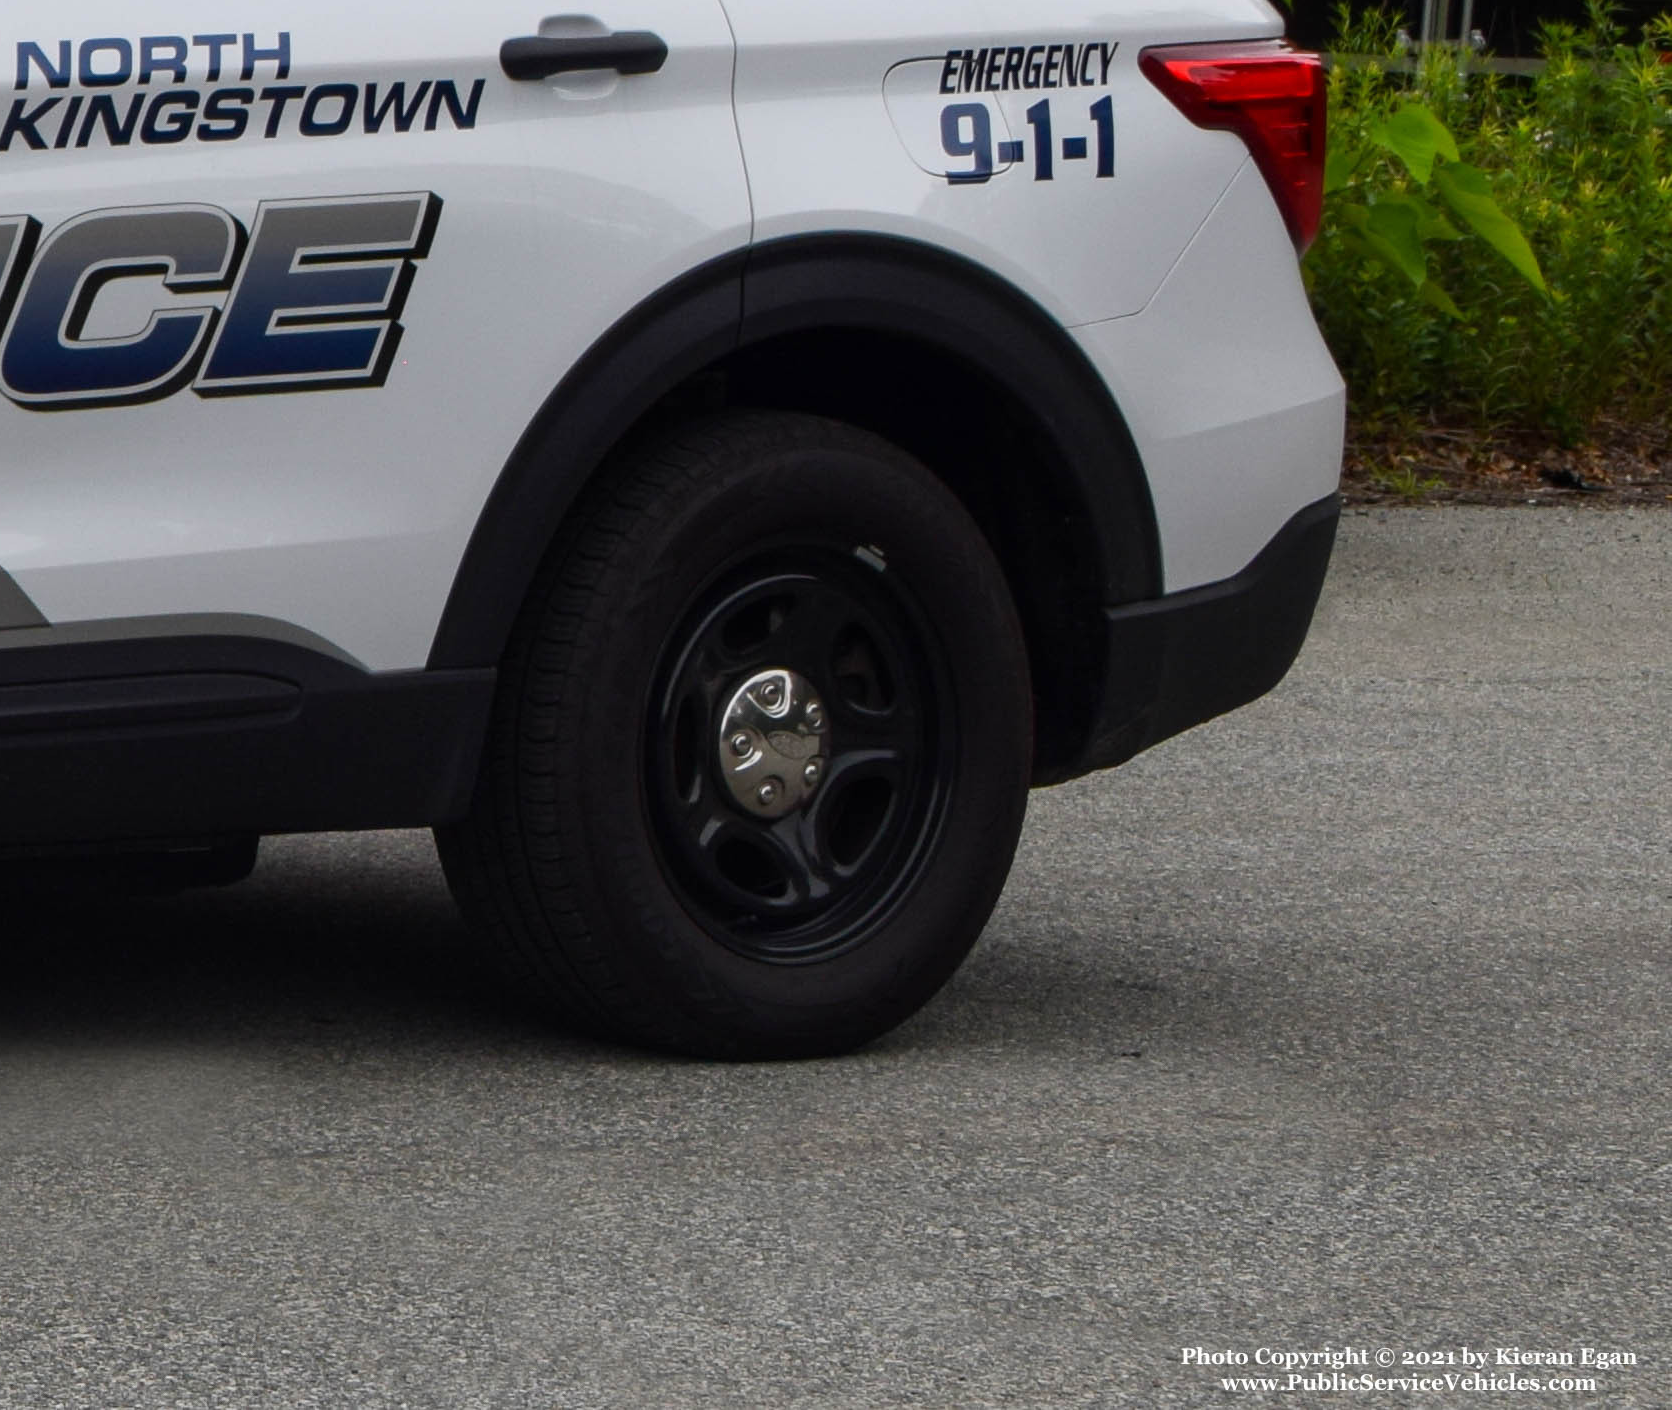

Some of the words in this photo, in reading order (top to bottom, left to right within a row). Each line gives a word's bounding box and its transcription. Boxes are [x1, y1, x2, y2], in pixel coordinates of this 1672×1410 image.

[13, 31, 291, 91] NORTH
[938, 41, 1120, 95] EMERGENCY
[940, 94, 1115, 186] 9-1-1
